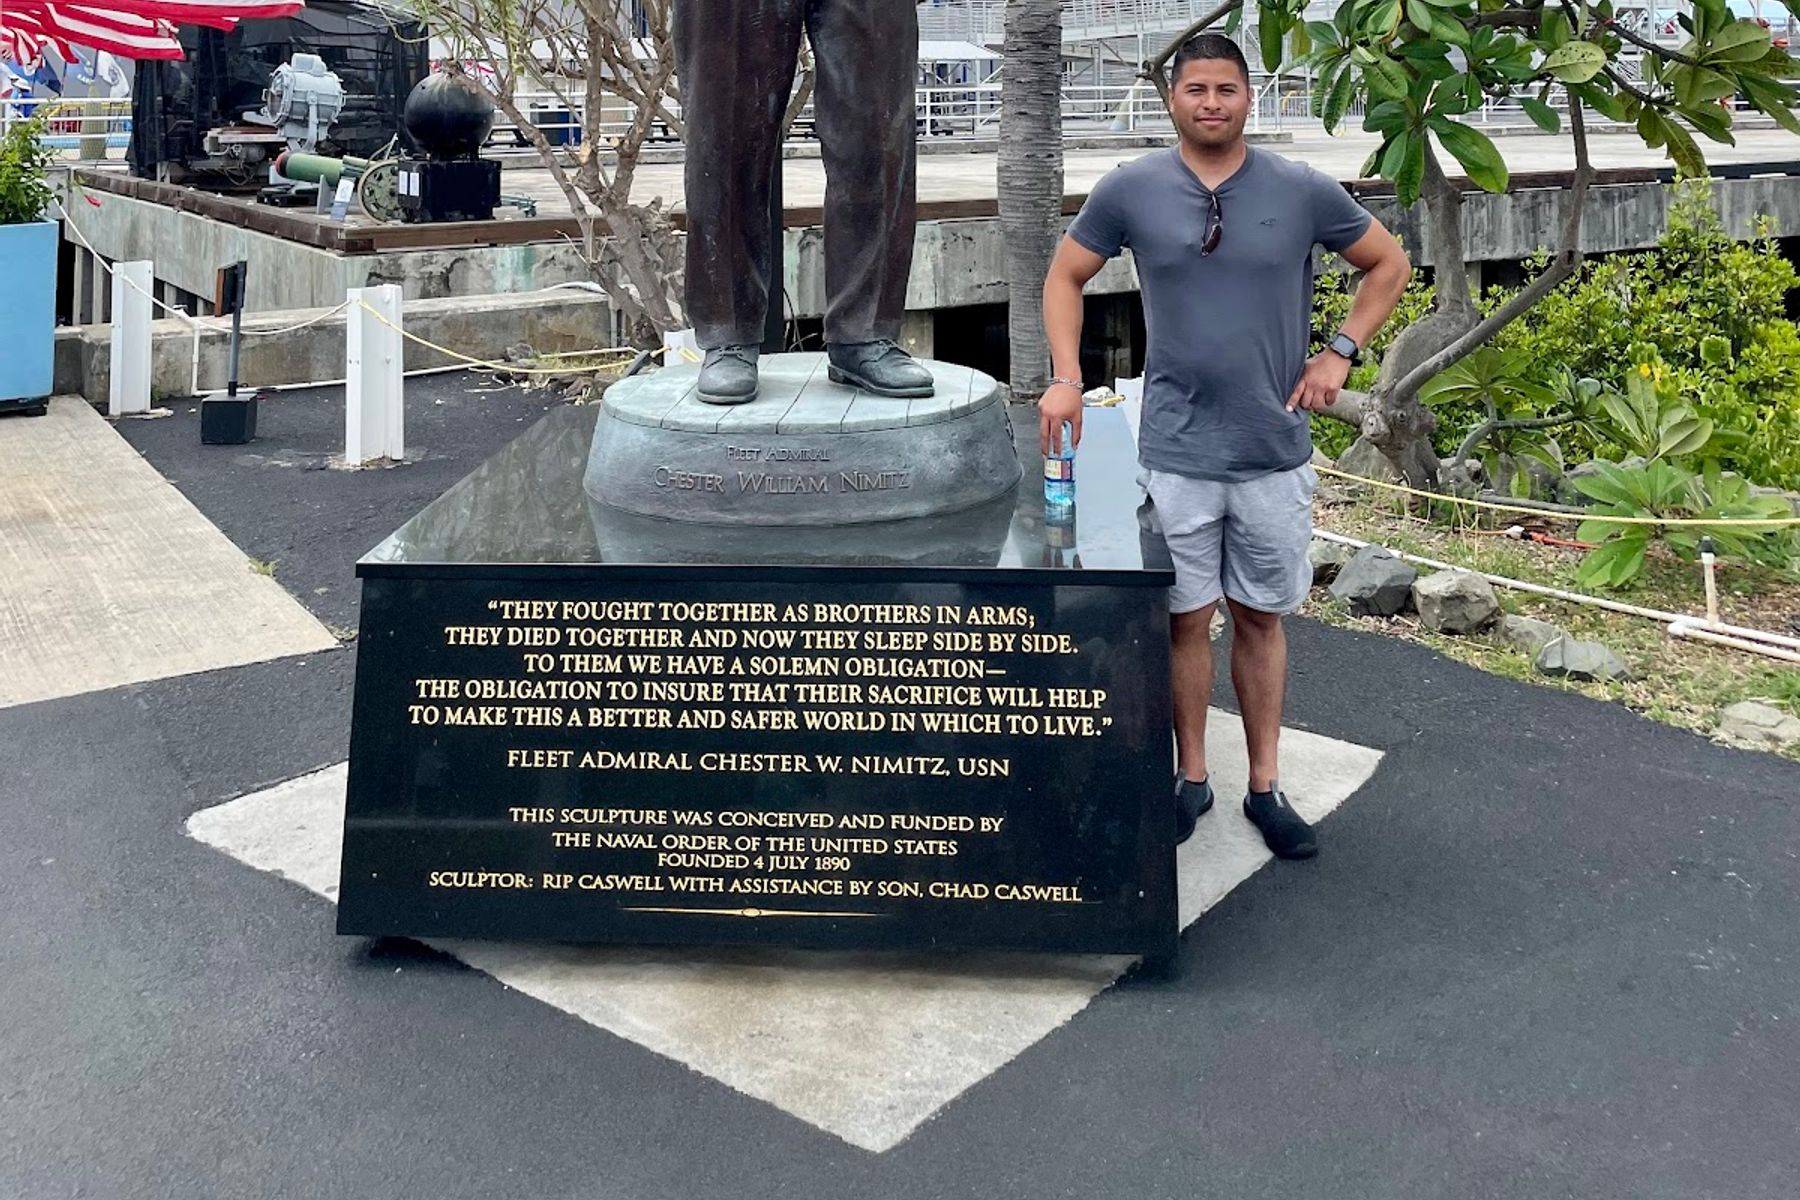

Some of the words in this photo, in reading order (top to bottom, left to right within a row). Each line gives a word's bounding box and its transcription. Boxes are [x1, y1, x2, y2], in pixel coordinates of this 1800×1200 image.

[563, 602, 655, 620] FOUGHT
[659, 602, 777, 621] TOGETHER
[782, 604, 808, 622] AS
[814, 604, 931, 623] BROTHERS
[936, 606, 960, 624] IN
[966, 606, 1034, 629] ARMS;
[445, 627, 503, 645] THEY
[508, 627, 560, 645] DIED
[566, 628, 684, 647] TOGETHER
[689, 629, 737, 647] AND
[742, 630, 796, 648] NOW
[800, 631, 860, 649] THEY
[864, 631, 928, 650] SLEEP
[933, 632, 983, 651] SIDE
[988, 633, 1016, 652] BY
[1022, 634, 1078, 653] SIDE.
[524, 654, 554, 672] TO
[560, 654, 622, 673] THEM
[628, 655, 662, 674] WE
[667, 656, 725, 674] HAVE
[730, 657, 745, 674] A
[750, 656, 839, 675] SOLEMN
[416, 680, 459, 698] THE
[465, 680, 602, 699] OBLIGATION
[606, 682, 637, 700] TO
[643, 682, 724, 701] INSURE
[729, 683, 790, 702] THAT
[794, 684, 863, 703] THEIR
[868, 685, 982, 705] SACRIFICE
[986, 687, 1043, 707] WILL
[1048, 689, 1106, 708] HELP
[409, 706, 439, 725] TO
[444, 707, 507, 725] MAKE
[512, 707, 562, 726] THIS
[567, 708, 583, 726] A
[588, 708, 673, 727] BETTER
[677, 710, 725, 728] AND
[731, 710, 798, 729] SAFER
[803, 711, 885, 731] WORLD
[890, 713, 915, 731] IN
[921, 713, 1001, 733] WHICH
[1006, 715, 1038, 734] TO
[508, 750, 574, 767] FLEET
[579, 751, 692, 770] ADMIRAL
[700, 753, 812, 772] CHESTER
[816, 755, 842, 773] W.
[851, 756, 950, 776] NIMITZ,
[958, 758, 1009, 776] USN
[509, 808, 554, 822] THIS
[560, 809, 667, 824] SCULPTURE
[672, 811, 712, 825] WAS
[718, 812, 834, 828] CONCEIVED
[838, 815, 884, 829] AND
[891, 815, 974, 831] FUNDED
[980, 817, 1004, 831] BY
[552, 833, 591, 847] THE
[597, 833, 658, 849] NAVAL
[662, 835, 732, 851] ORDER
[735, 836, 761, 851] OF
[766, 837, 805, 852] THE
[811, 838, 888, 853] UNITED
[894, 839, 957, 855] STATES
[659, 853, 749, 870] FOUNDED
[754, 856, 764, 871] 4
[767, 855, 809, 872] JULY
[815, 857, 850, 872] 1890
[430, 872, 533, 887] SCULPTOR:
[543, 874, 573, 888] RIP
[578, 875, 664, 890] CASWELL
[668, 877, 724, 892] WITH
[728, 878, 842, 894] ASSISTANCE
[850, 881, 873, 895] BY
[878, 881, 923, 897] SON,
[929, 882, 989, 898] CHAD
[995, 885, 1082, 901] CASWELL
